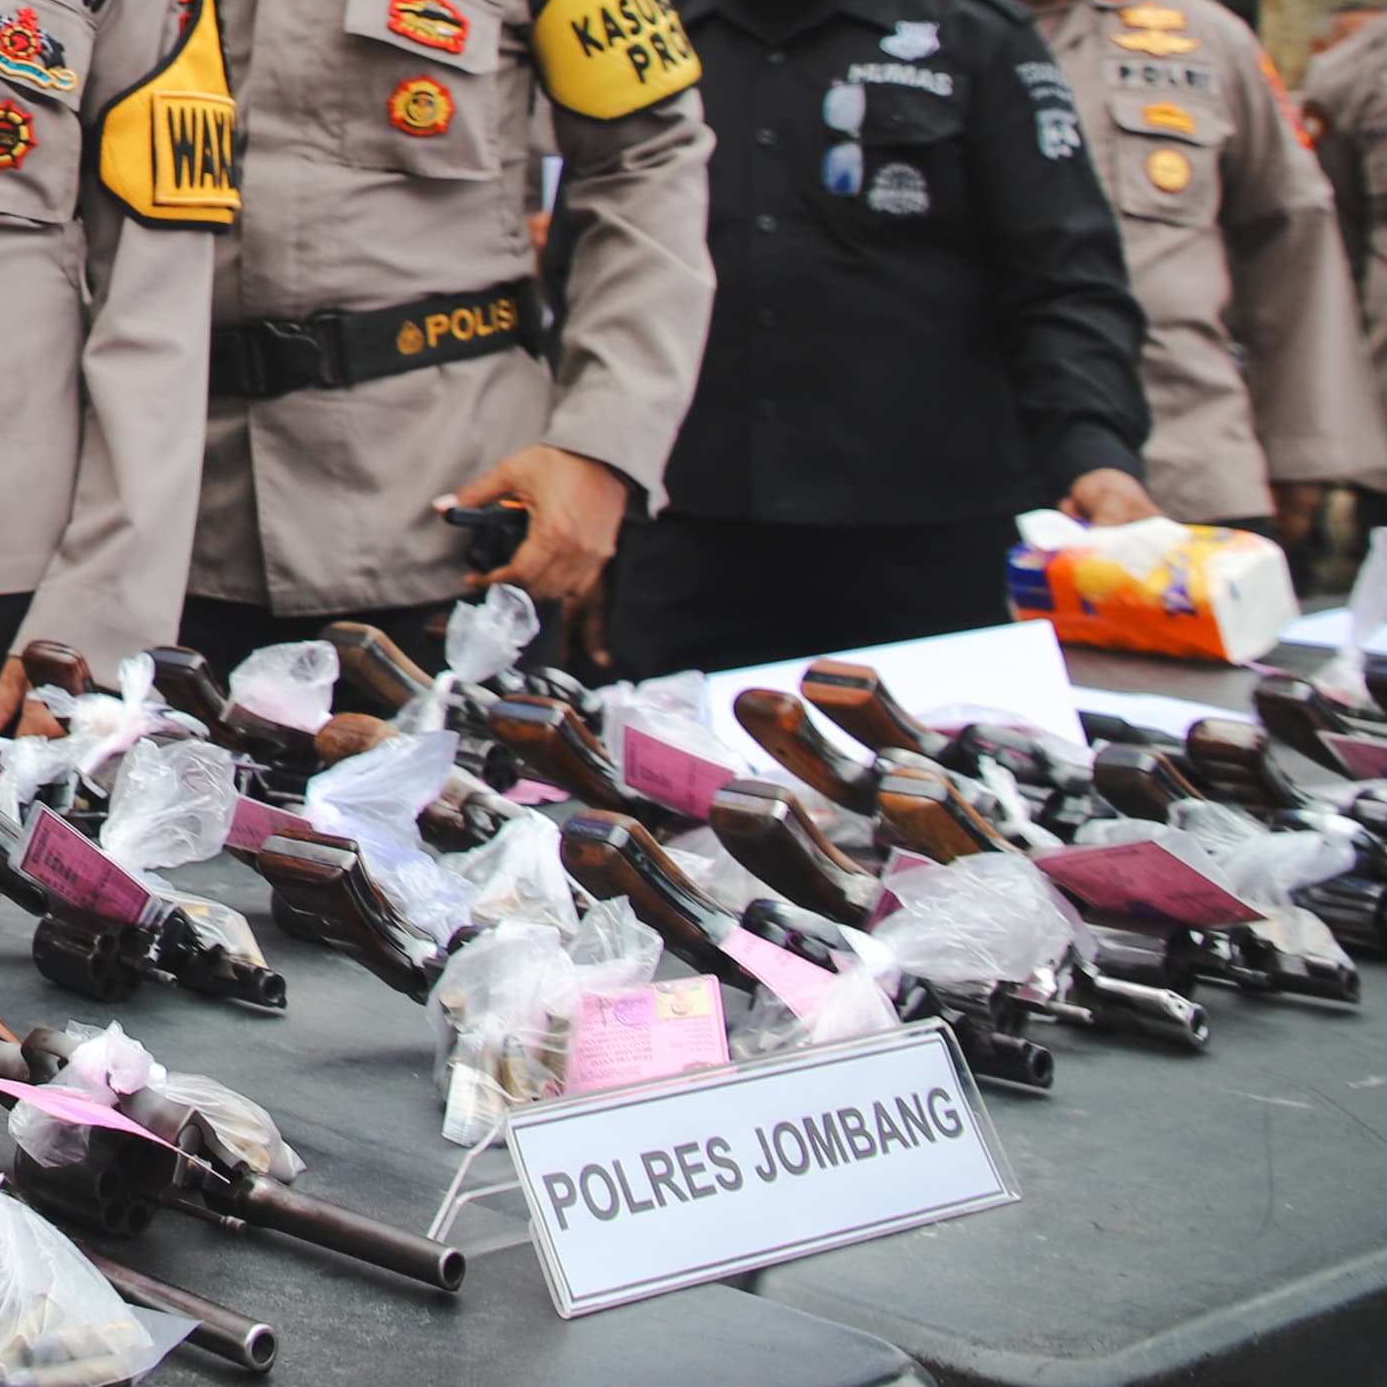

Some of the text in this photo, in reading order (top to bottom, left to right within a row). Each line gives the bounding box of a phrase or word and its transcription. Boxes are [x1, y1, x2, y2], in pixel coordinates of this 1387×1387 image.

[847, 61, 955, 98] HUMAS
[541, 1086, 965, 1232] POLRES JOMBANG
